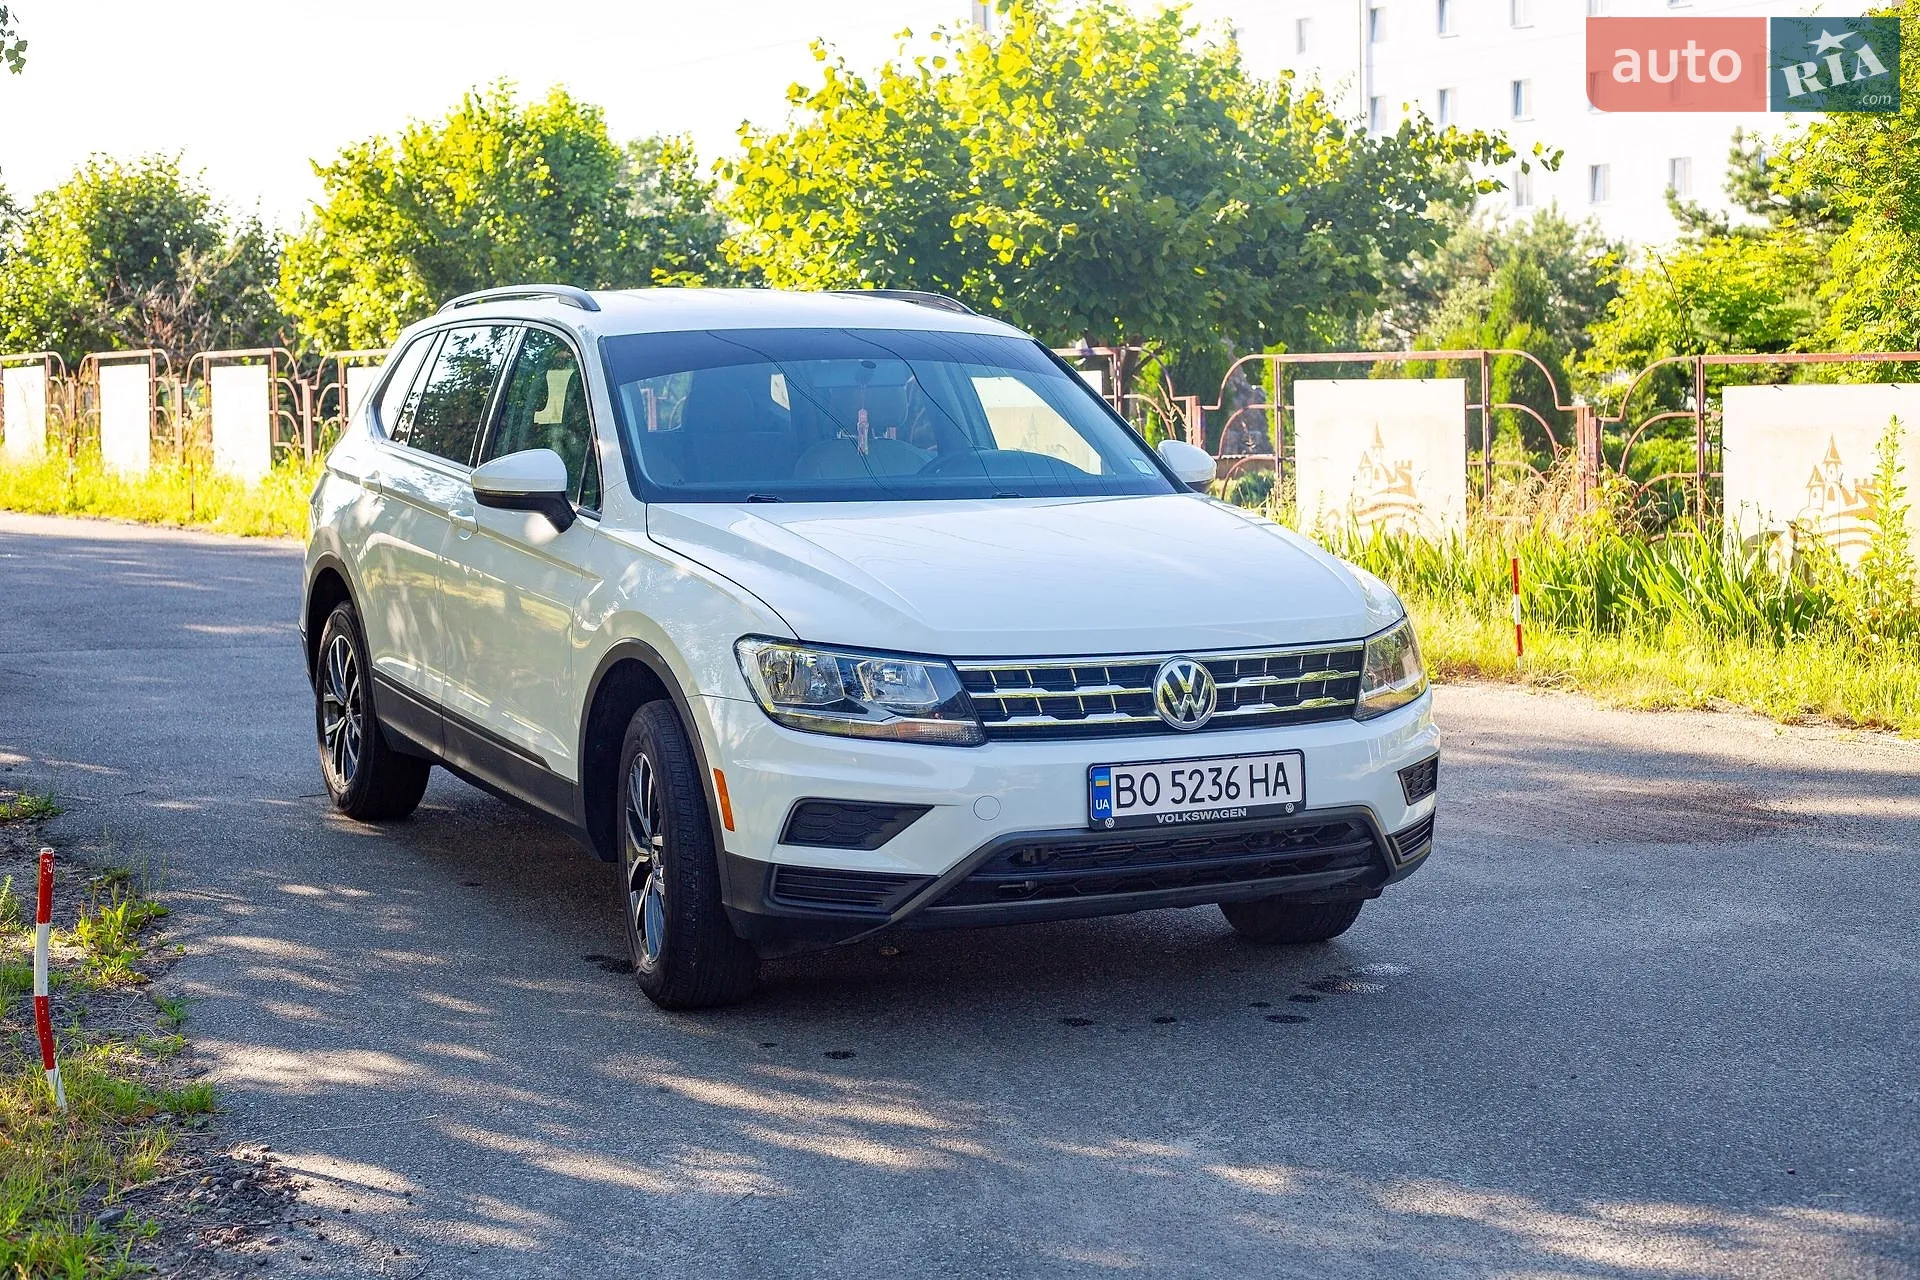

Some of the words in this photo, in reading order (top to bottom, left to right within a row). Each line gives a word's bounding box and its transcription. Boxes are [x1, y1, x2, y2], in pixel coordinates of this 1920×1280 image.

[1115, 772, 1161, 809] BO
[1170, 766, 1241, 805] 5236
[1249, 762, 1291, 798] HA
[1095, 799, 1110, 810] UA
[1156, 807, 1247, 824] VOLKSWAGEN
